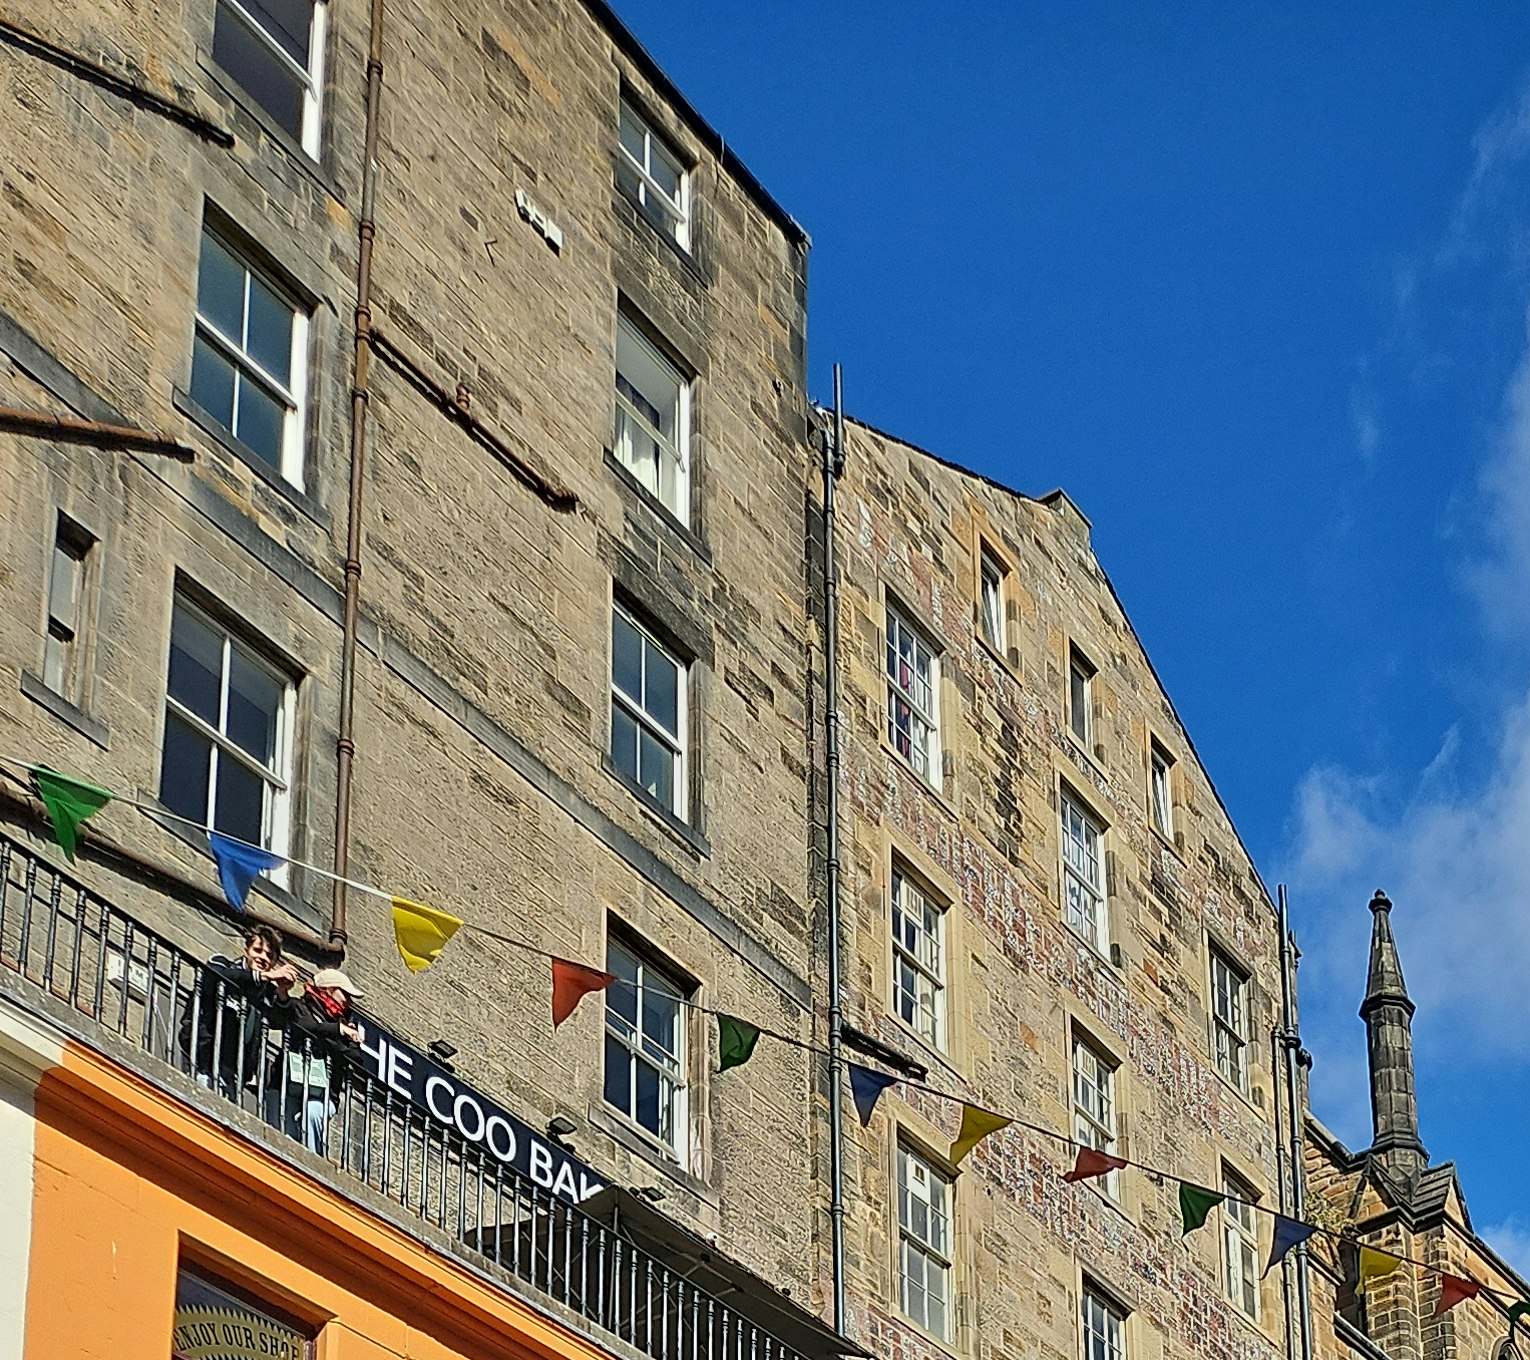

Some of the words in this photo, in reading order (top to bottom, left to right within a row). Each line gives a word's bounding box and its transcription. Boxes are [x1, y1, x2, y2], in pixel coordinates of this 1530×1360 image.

[359, 1021, 413, 1100] HE
[425, 1076, 517, 1162] COO
[173, 1322, 221, 1353] ENJOY
[222, 1324, 256, 1351] OUR
